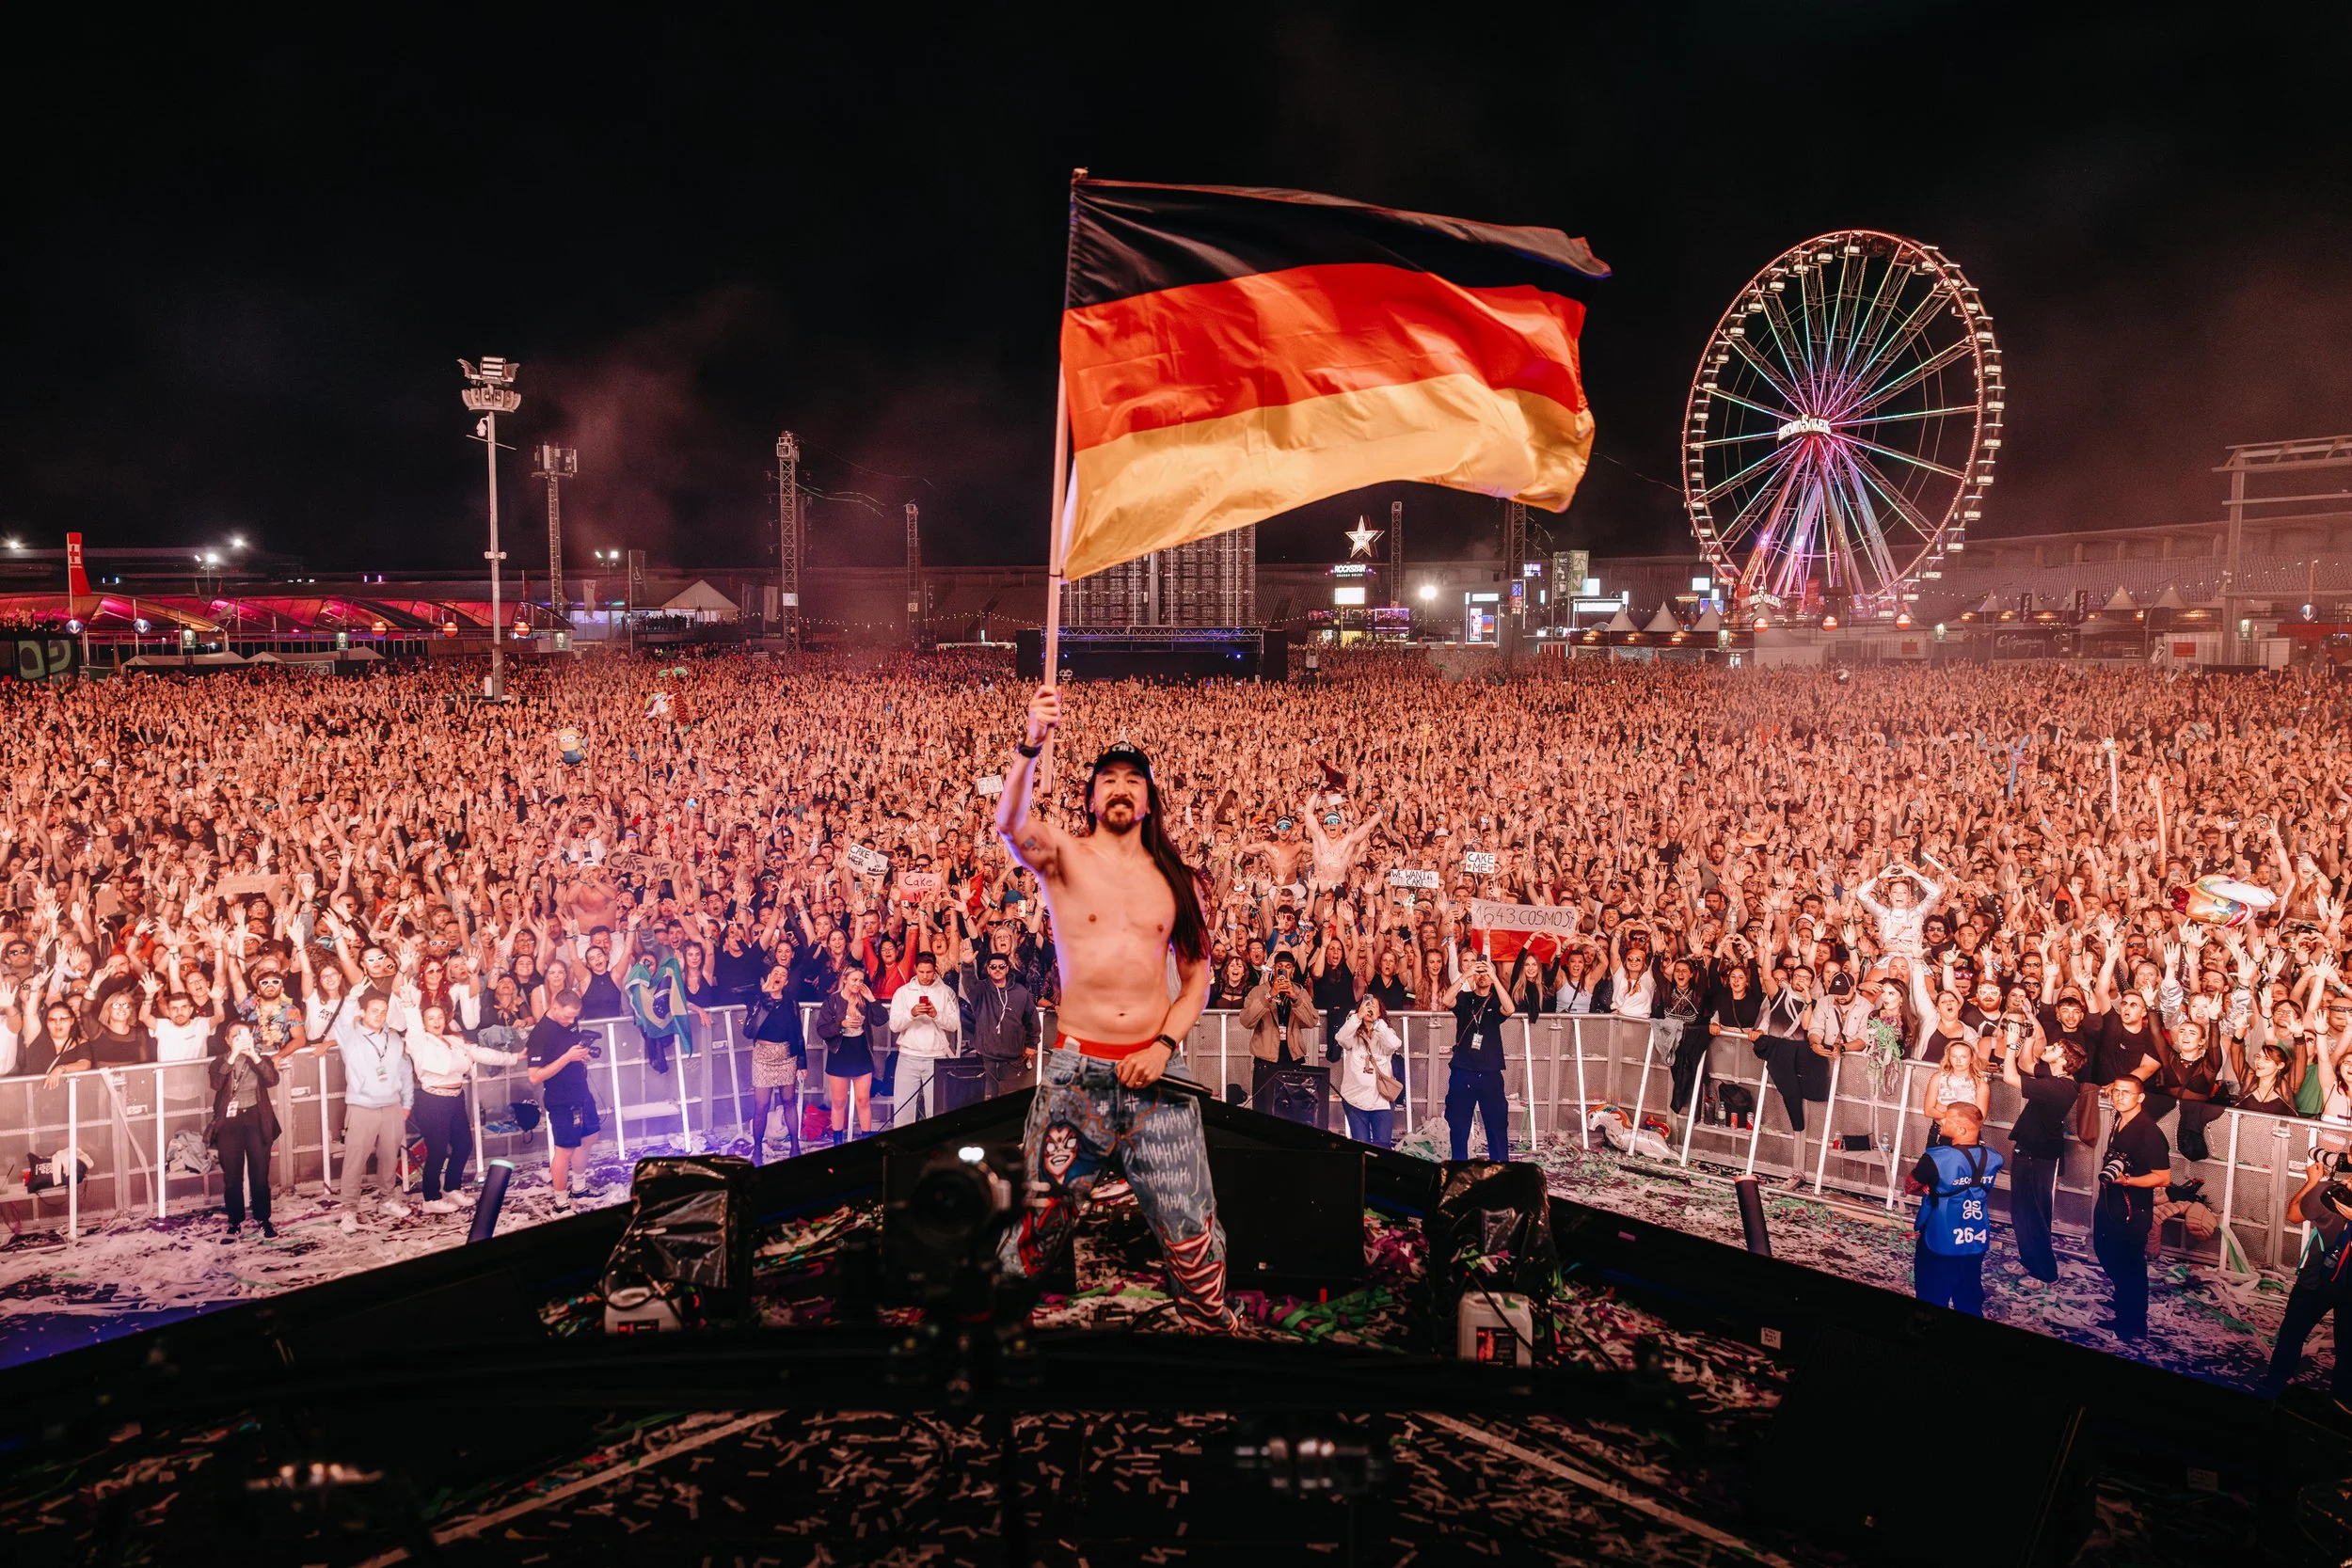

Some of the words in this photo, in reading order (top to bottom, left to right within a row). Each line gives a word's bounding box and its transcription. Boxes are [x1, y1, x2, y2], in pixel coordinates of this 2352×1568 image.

[1334, 564, 1366, 573] ROCKSTAR
[850, 845, 870, 860] CAKE
[1468, 853, 1494, 864] CAKE
[1472, 863, 1487, 872] ME
[1953, 1227, 1987, 1244] 264
